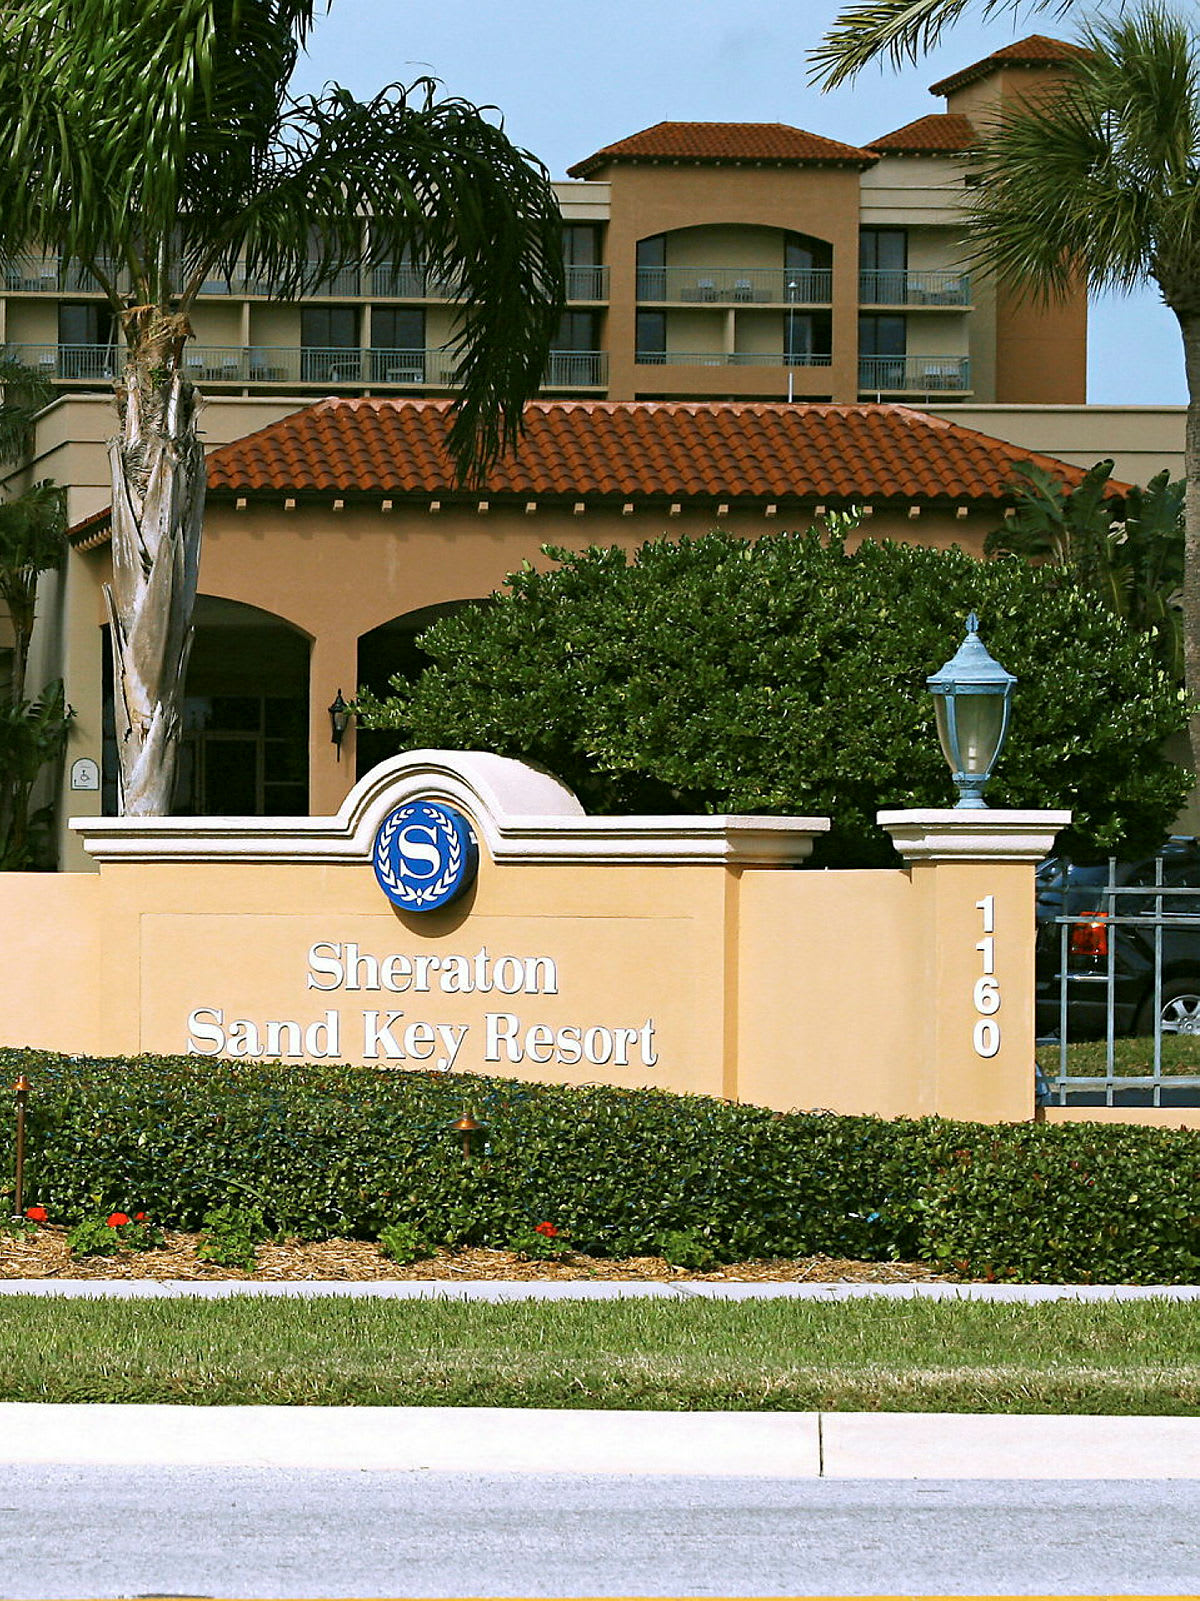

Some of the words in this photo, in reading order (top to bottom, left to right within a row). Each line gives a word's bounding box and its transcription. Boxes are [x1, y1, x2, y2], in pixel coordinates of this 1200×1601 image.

[398, 825, 441, 880] S
[306, 942, 559, 994] Sheraton
[973, 894, 1001, 1058] 1160
[186, 1008, 341, 1059] Sand
[362, 1010, 469, 1072] Key
[484, 1012, 659, 1067] Resort
